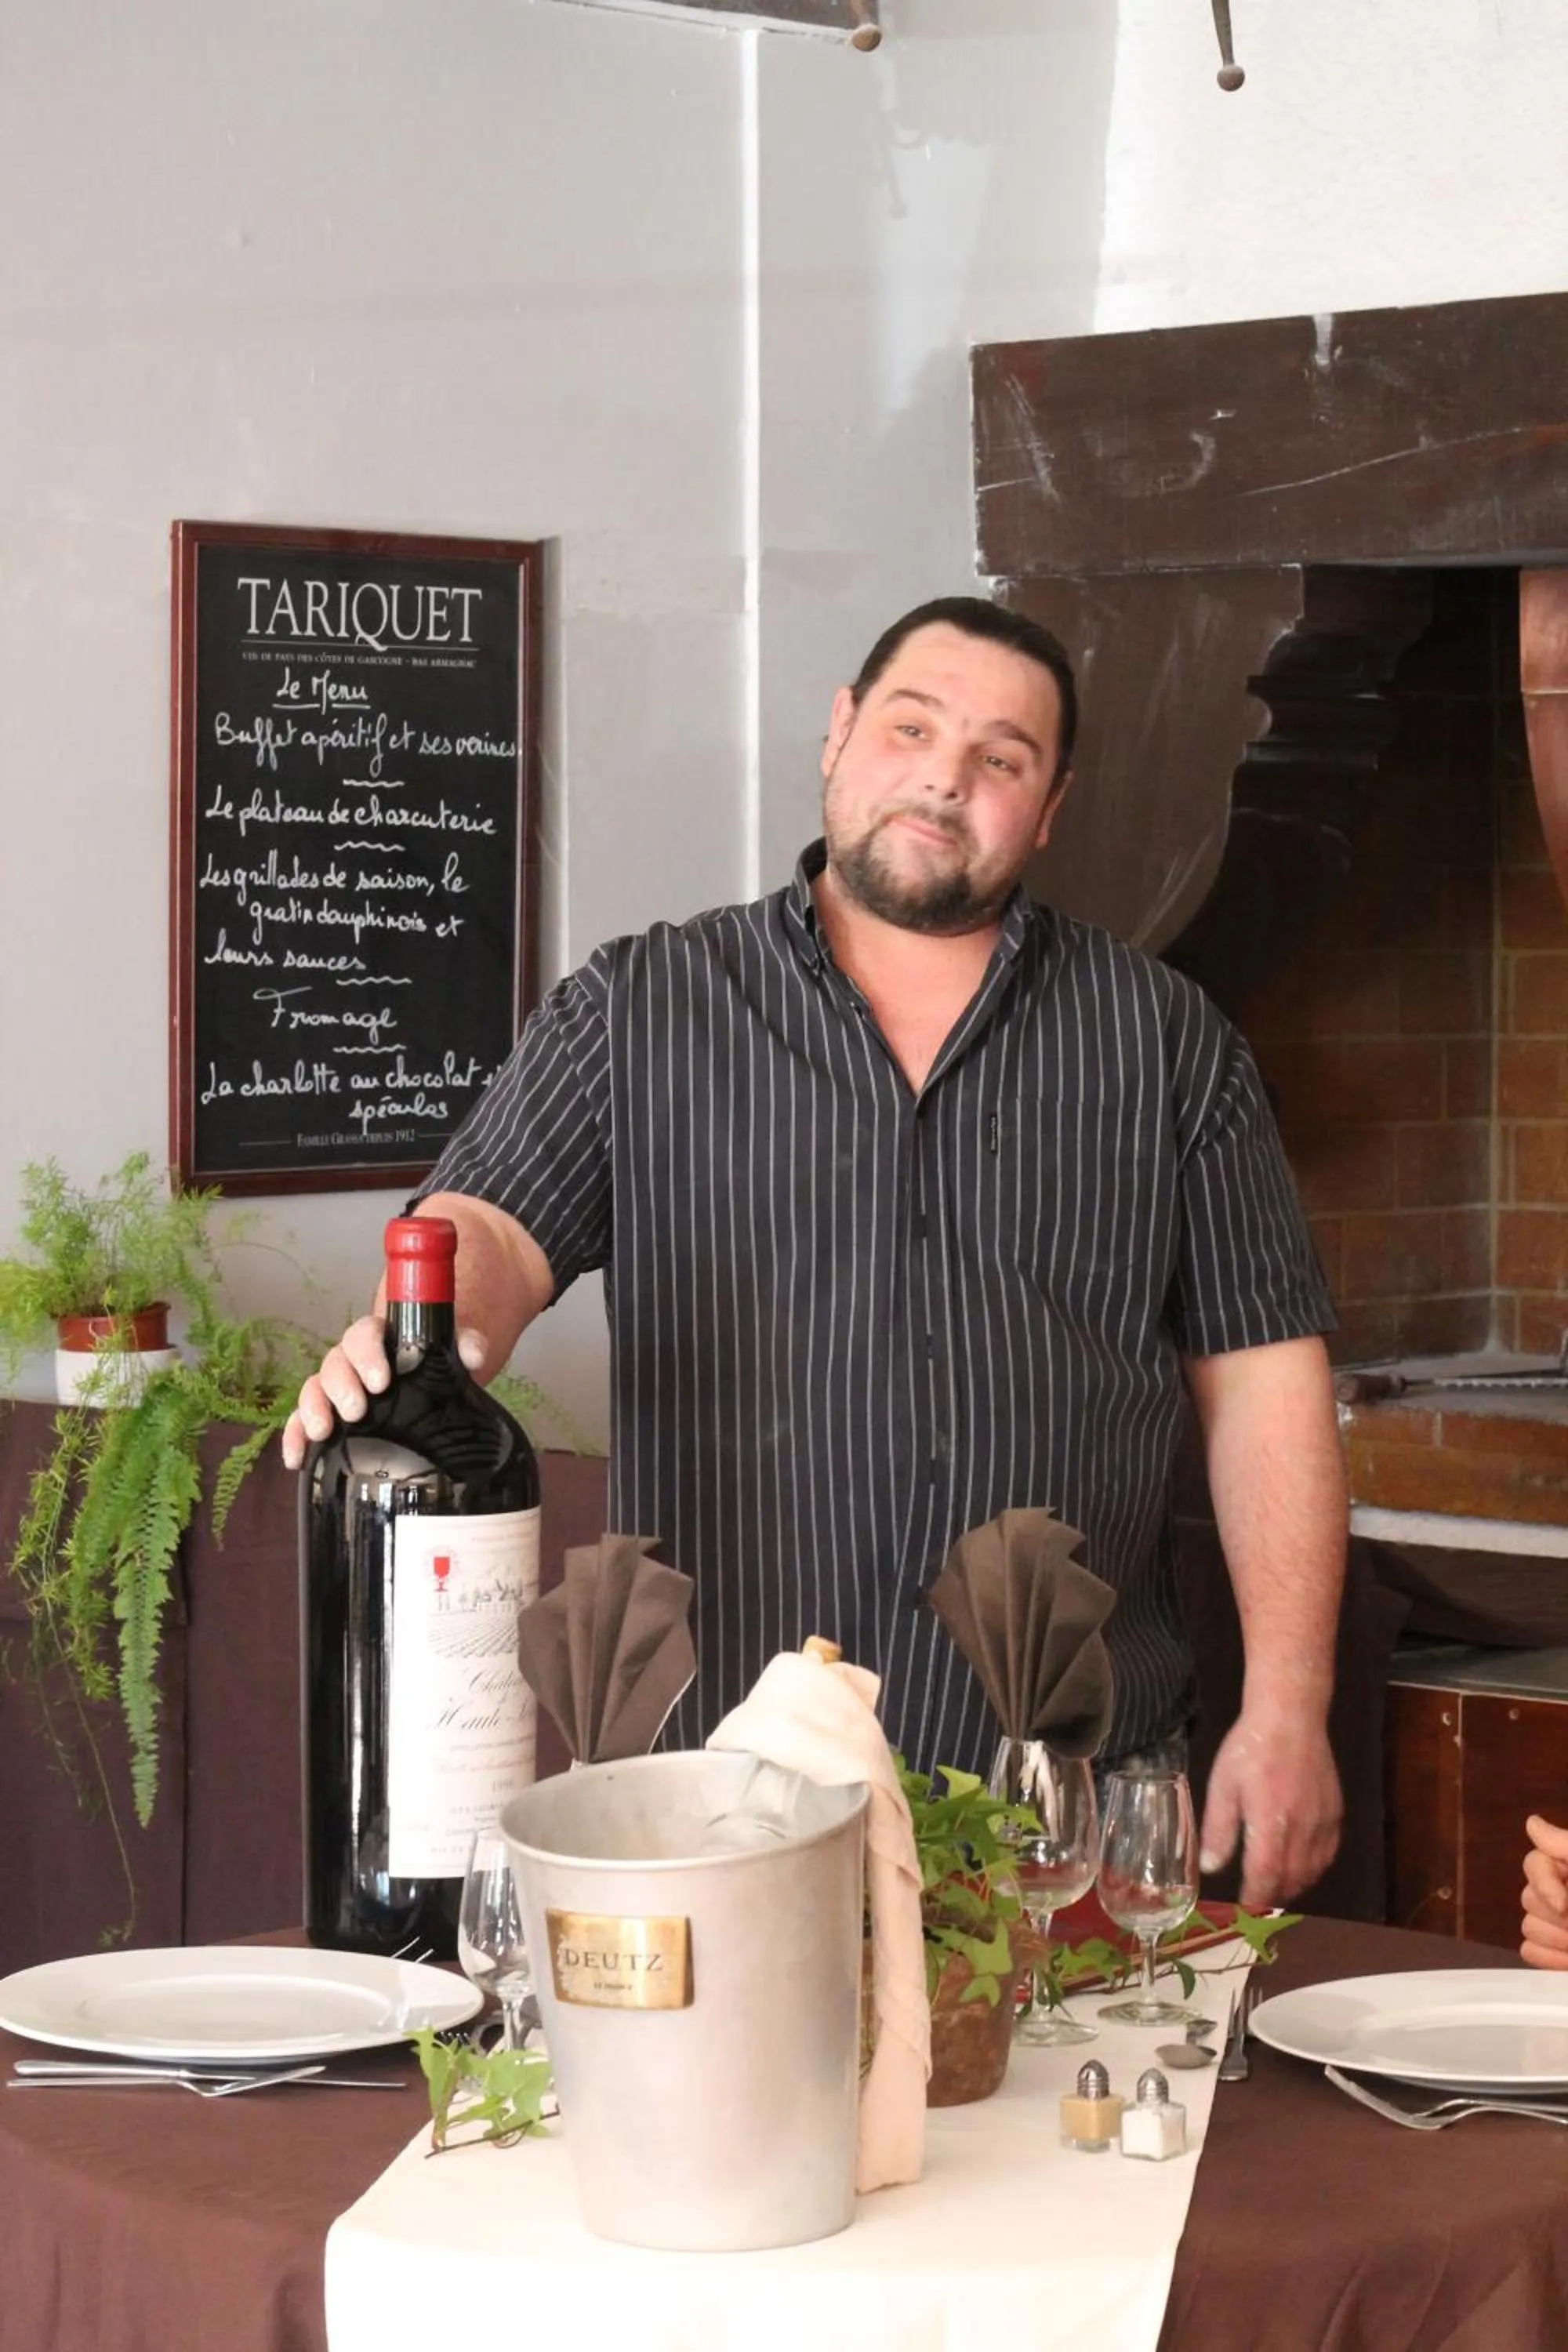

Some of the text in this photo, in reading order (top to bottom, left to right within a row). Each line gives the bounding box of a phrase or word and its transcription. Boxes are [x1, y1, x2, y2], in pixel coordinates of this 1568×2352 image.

[238, 577, 482, 652] TARIQUET
[276, 666, 368, 714] Le Menu
[215, 712, 298, 771] Buffet
[389, 720, 416, 751] et
[205, 785, 497, 837] Le plateau de charcuterie
[200, 852, 230, 888] Les
[322, 862, 347, 889] de
[441, 851, 470, 892] le
[282, 949, 367, 970] sauces
[253, 985, 397, 1044] Fromage
[201, 1062, 234, 1105] La
[240, 1059, 342, 1097] charlotte
[350, 1075, 380, 1090] au
[384, 1051, 482, 1088] chocolat
[563, 1947, 663, 1971] DEUTZ
